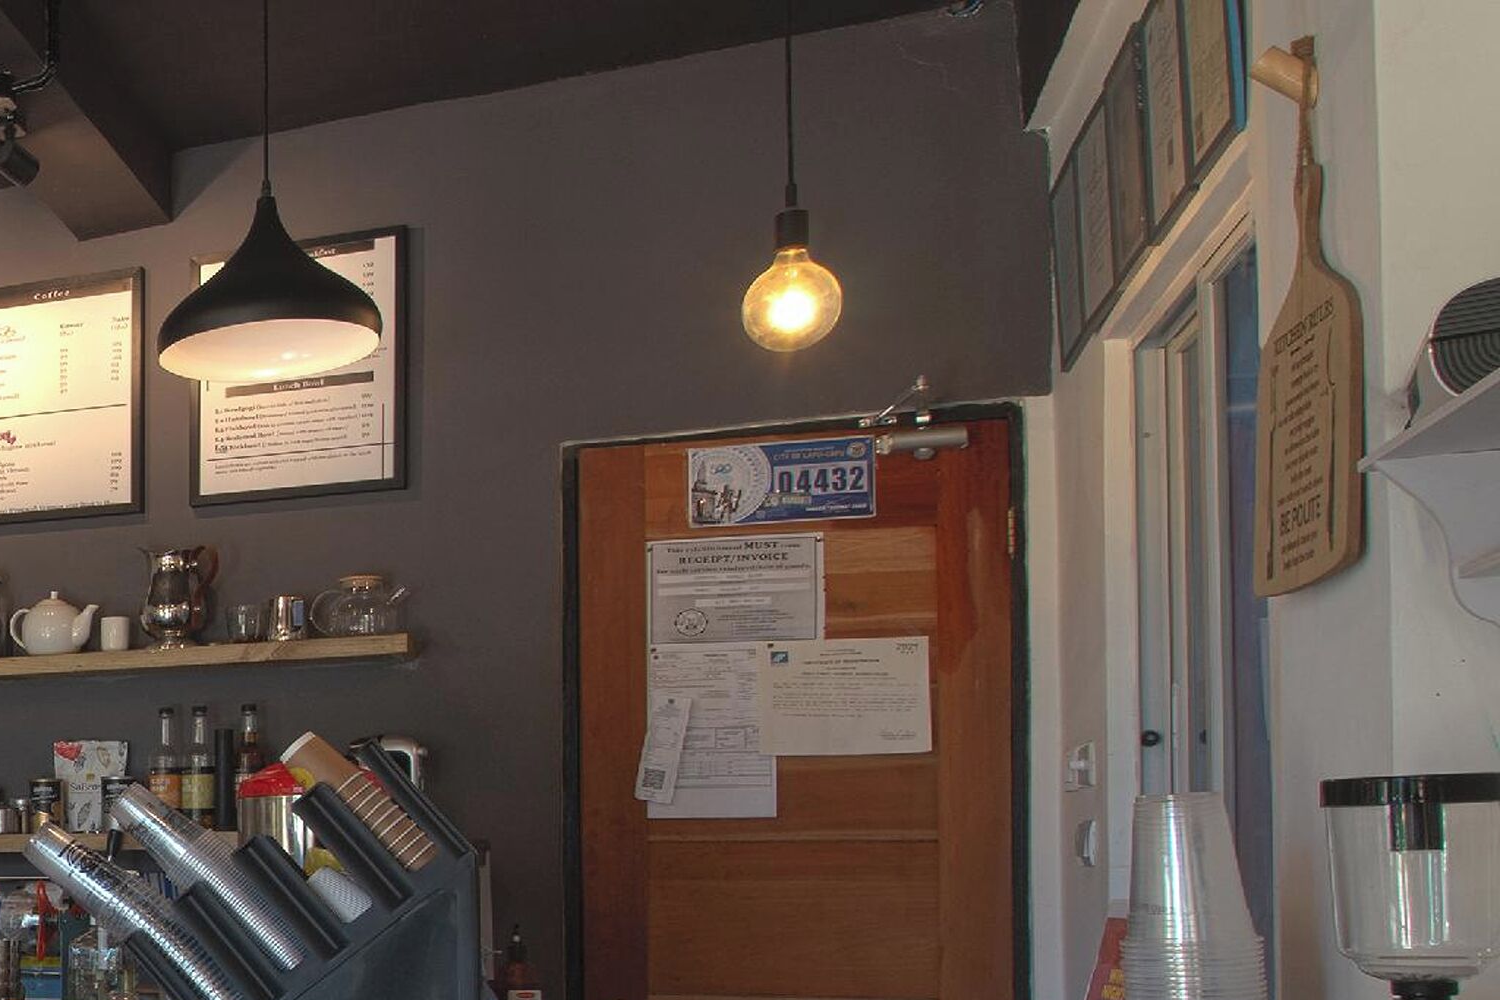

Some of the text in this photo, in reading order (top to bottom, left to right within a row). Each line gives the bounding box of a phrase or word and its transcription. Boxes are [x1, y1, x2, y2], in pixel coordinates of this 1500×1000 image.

[33, 289, 70, 301] Coffee
[778, 465, 864, 495] 04432
[1280, 510, 1291, 536] BE
[744, 541, 779, 550] MUST
[678, 551, 790, 565] RECEIPT/INVOICE
